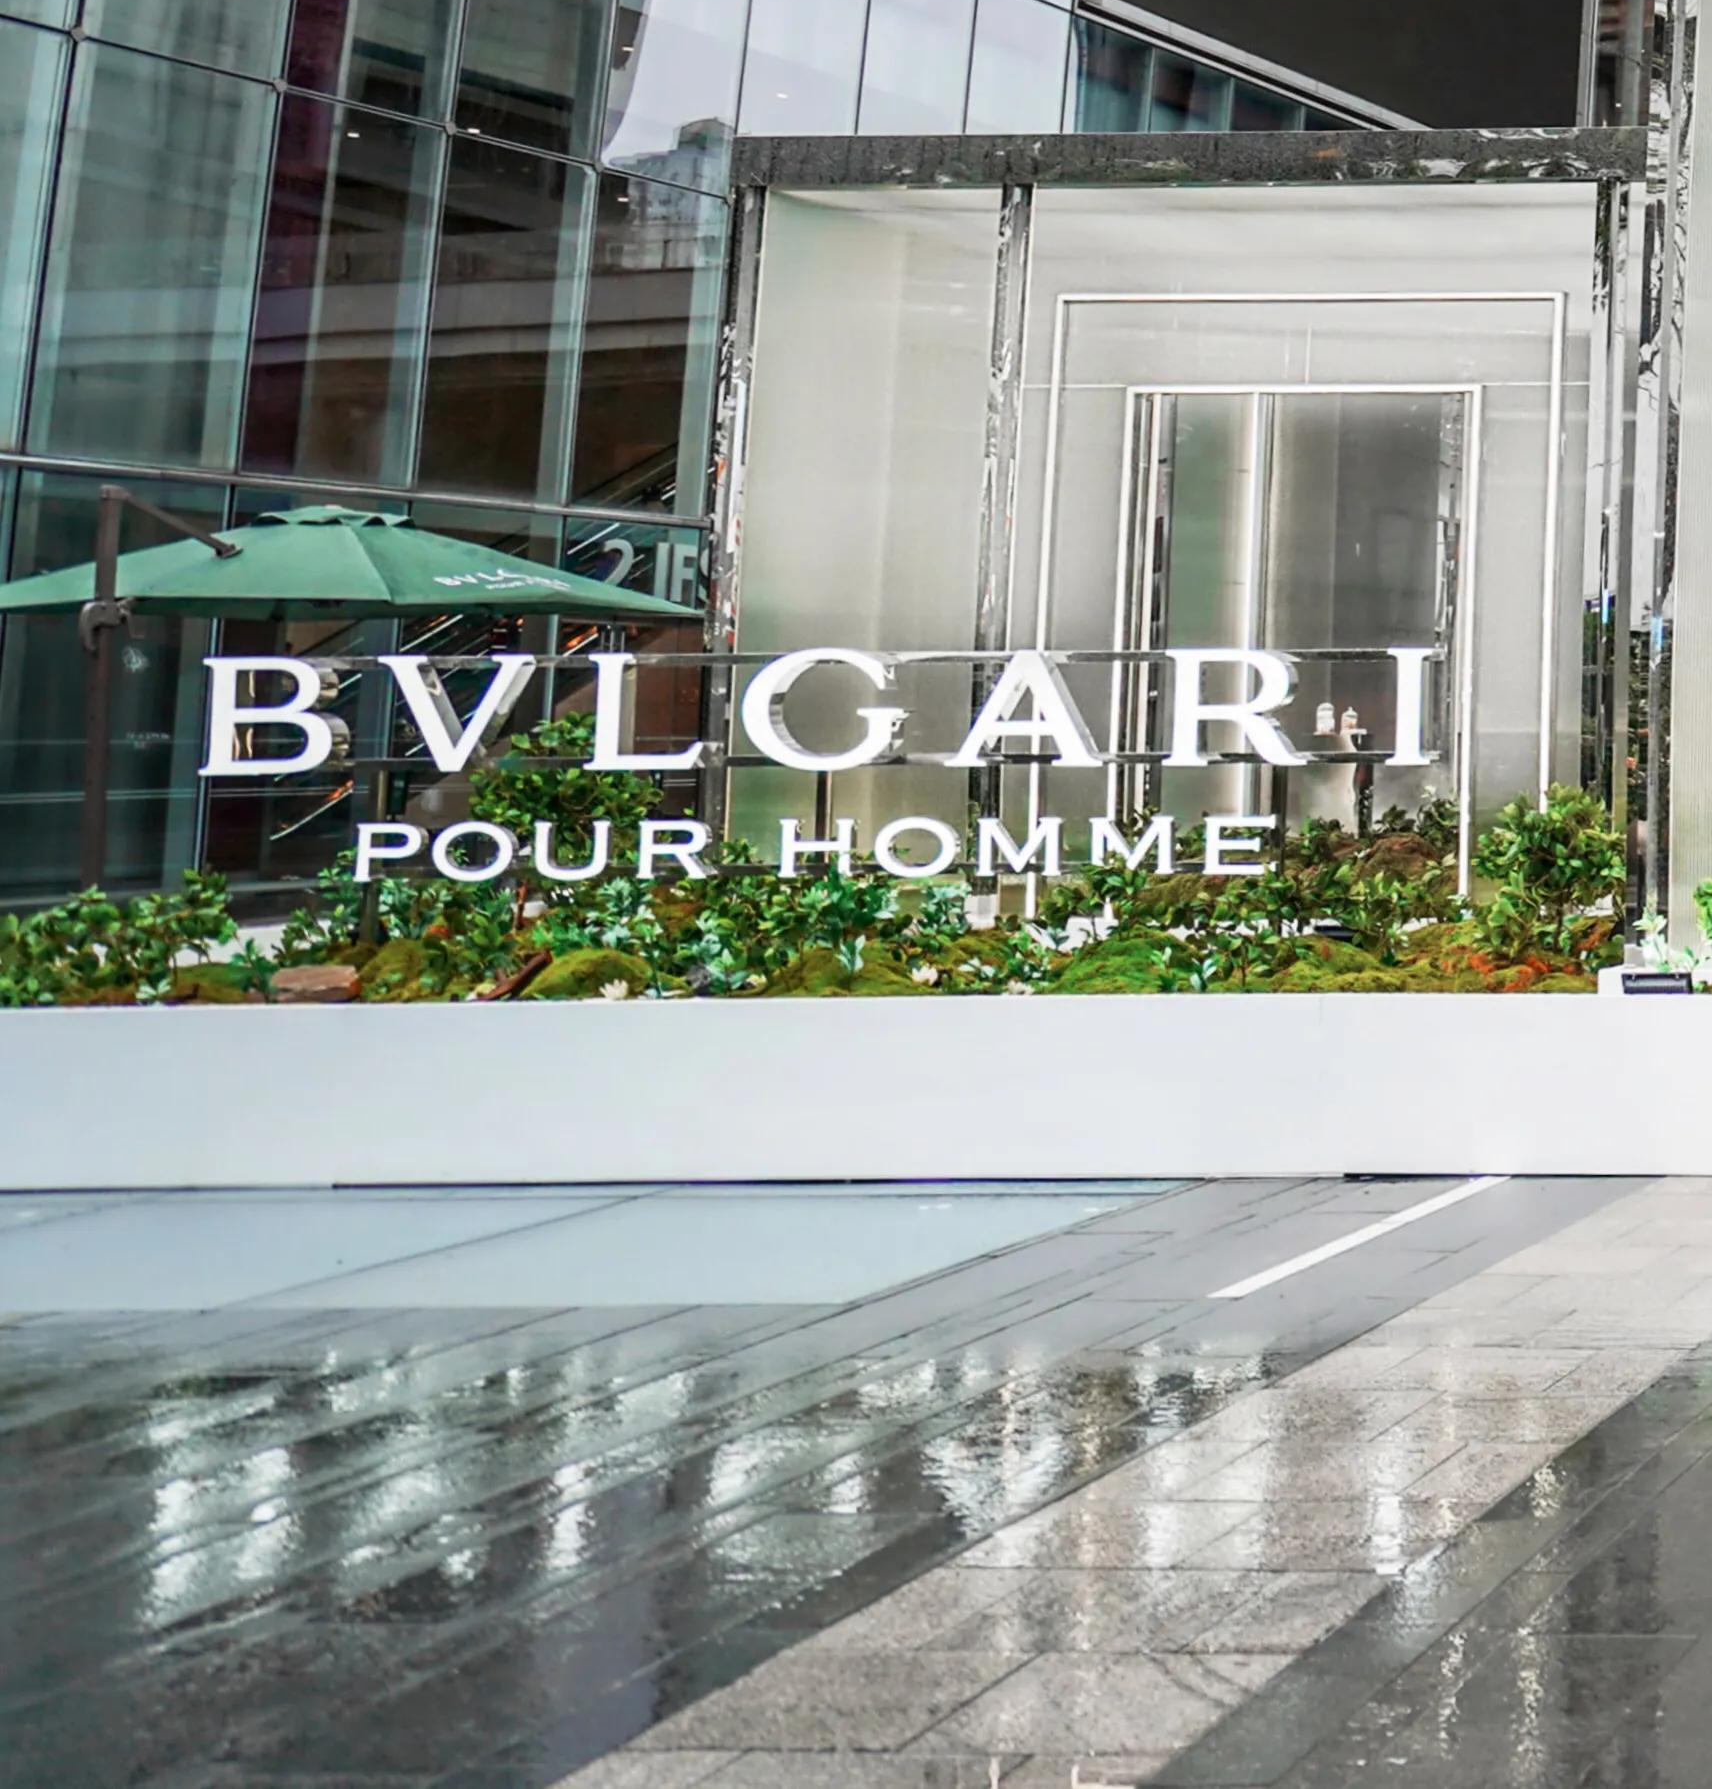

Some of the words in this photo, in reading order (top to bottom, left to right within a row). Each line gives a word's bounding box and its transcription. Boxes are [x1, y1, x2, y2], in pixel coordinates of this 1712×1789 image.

[198, 647, 1436, 776] BVLGARI
[353, 819, 714, 883] POUR
[778, 814, 1278, 879] HOMME
